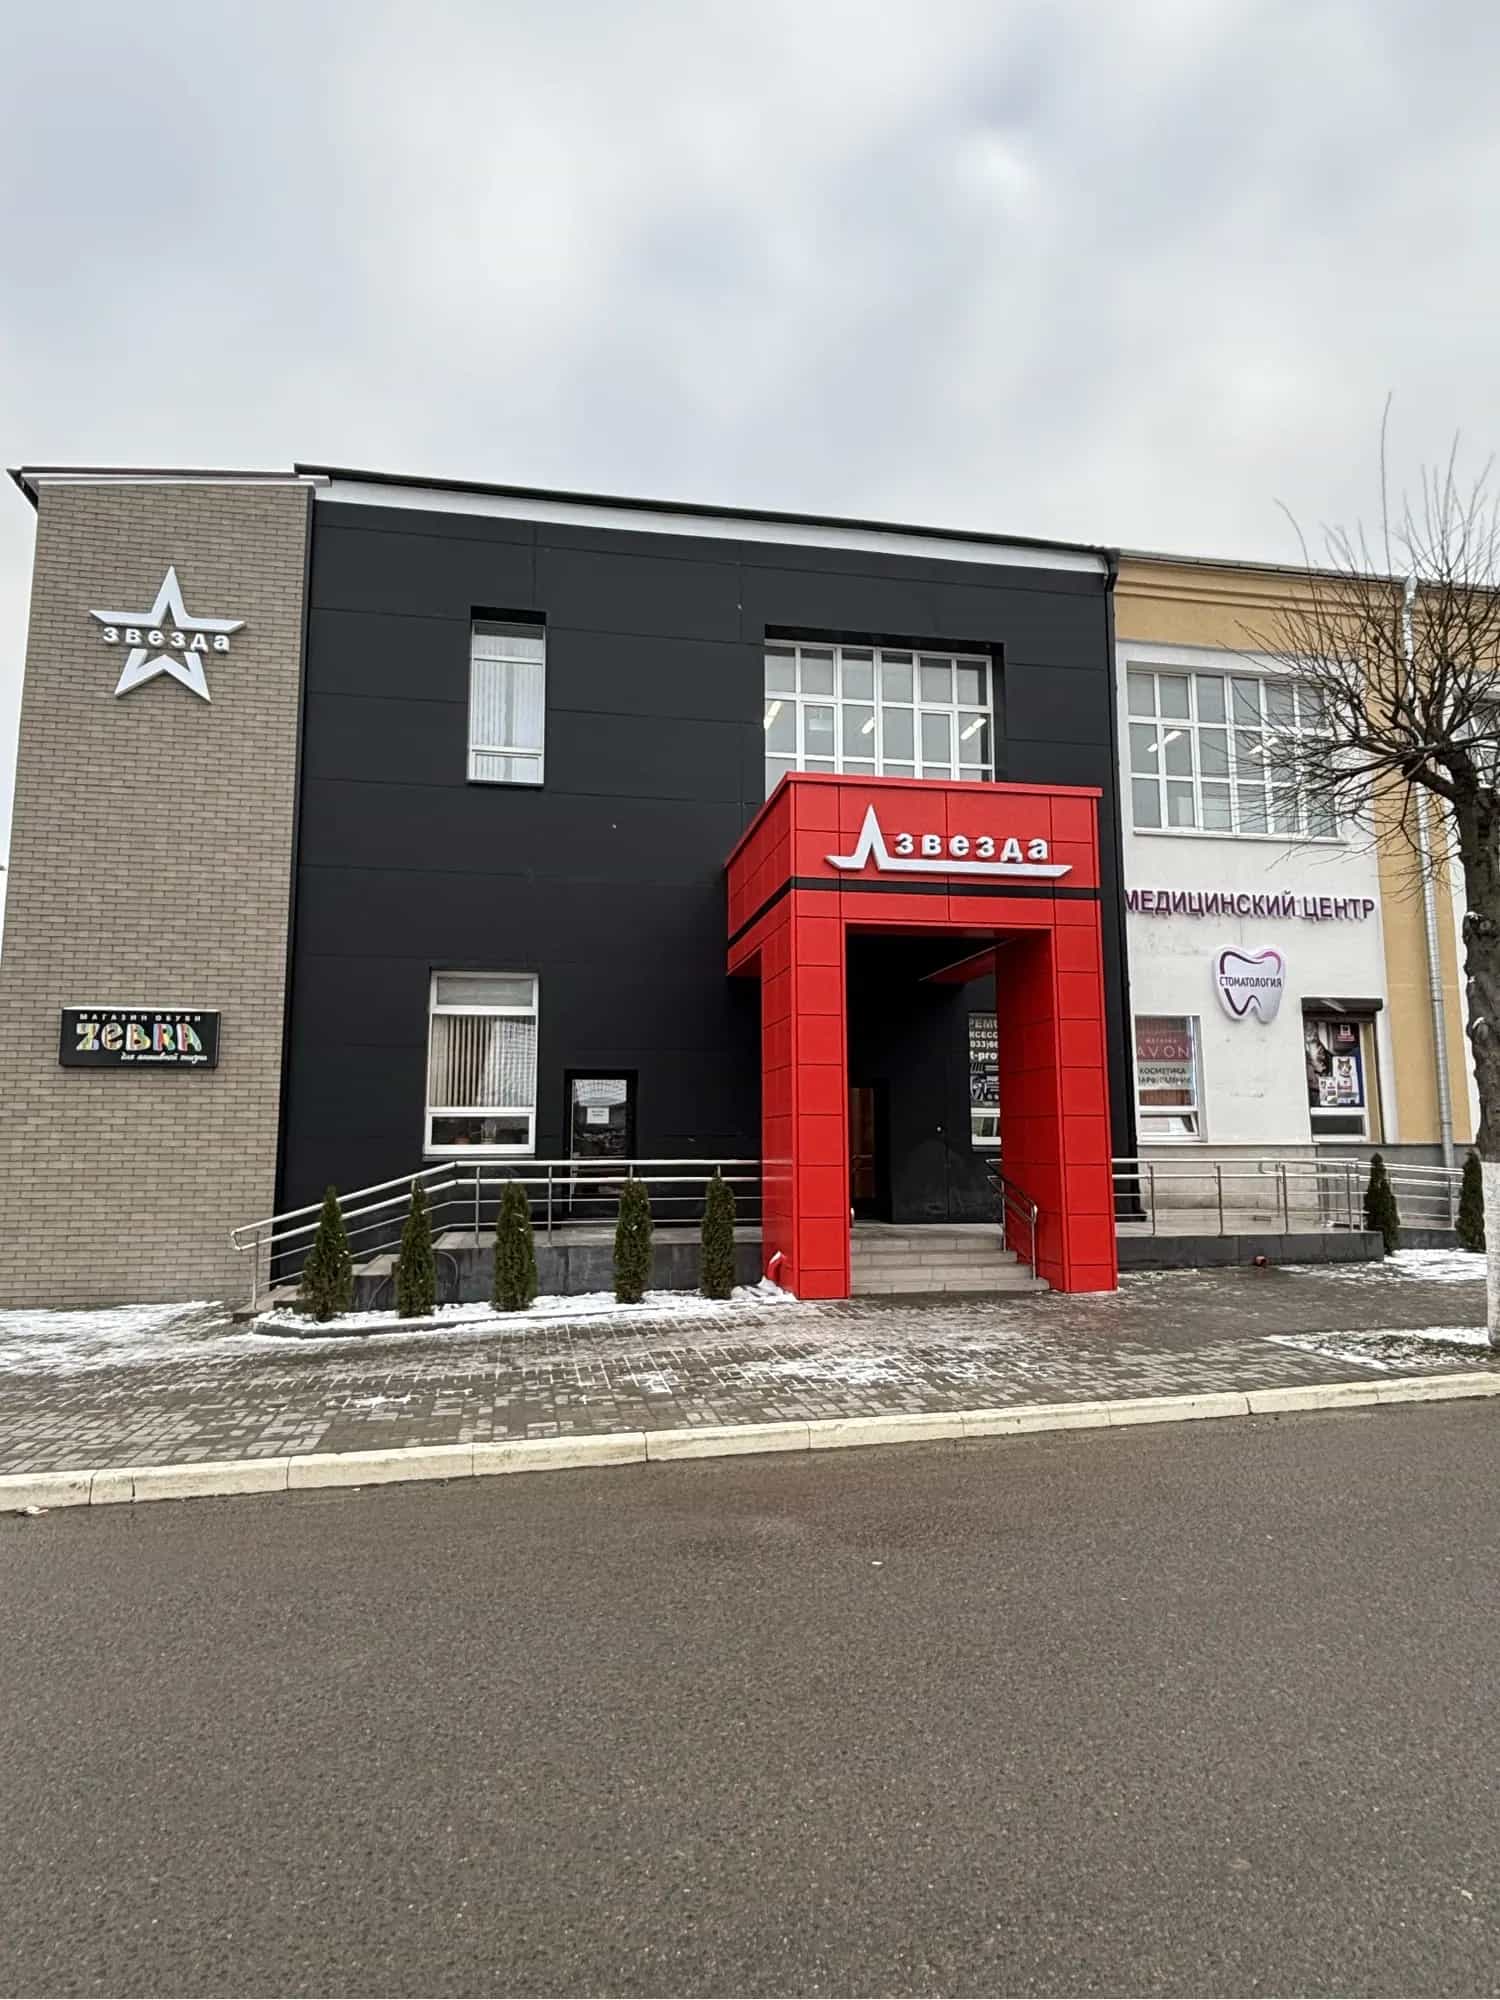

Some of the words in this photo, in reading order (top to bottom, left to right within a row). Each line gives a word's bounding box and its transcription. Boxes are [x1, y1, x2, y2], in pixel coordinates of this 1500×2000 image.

[103, 627, 231, 653] звезда
[895, 833, 1049, 863] звезда
[1124, 890, 1297, 918] МЕДИЦИНСКИЙ
[1303, 897, 1375, 922] ЦЕНТР
[1219, 976, 1282, 988] СТОМАТОЛОГИЯ
[79, 1013, 148, 1021] МАГАЗИН
[155, 1014, 201, 1022] ОБУВИ
[1137, 1045, 1190, 1057] AVON
